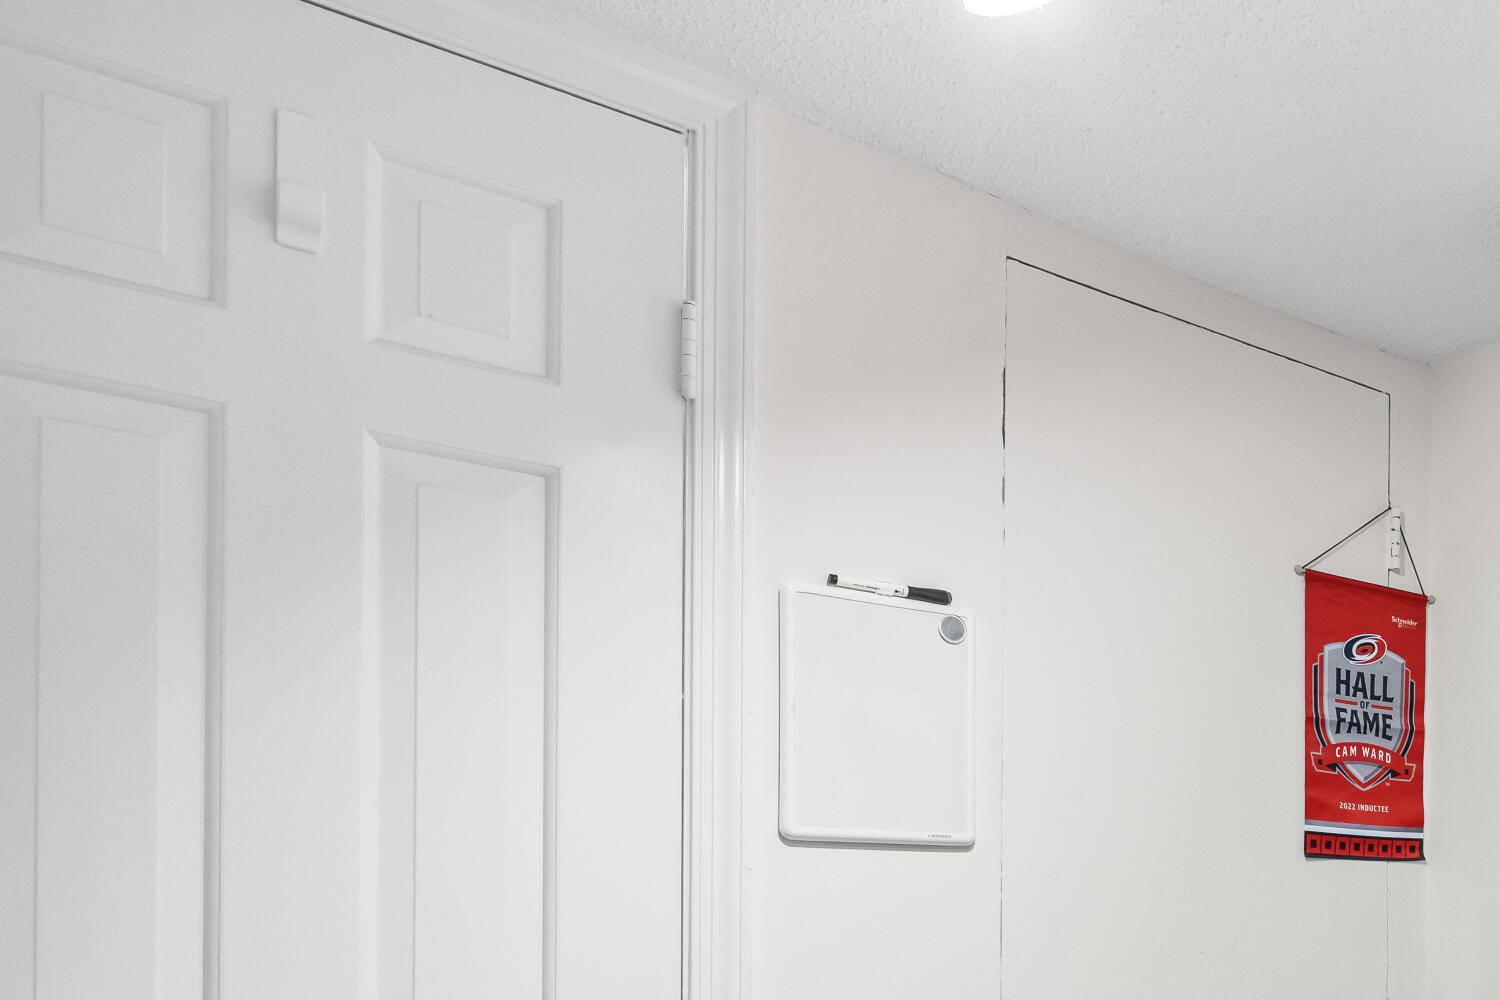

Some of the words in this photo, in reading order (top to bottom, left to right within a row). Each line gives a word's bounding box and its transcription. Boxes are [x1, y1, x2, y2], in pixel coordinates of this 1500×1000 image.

[1391, 616, 1418, 629] Schneider
[1335, 667, 1395, 703] HALL
[1359, 700, 1371, 710] OF
[1335, 709, 1394, 741] FAME
[1335, 746, 1358, 758] CAM
[1362, 746, 1392, 764] WARD
[1339, 801, 1357, 812] 2022
[1357, 803, 1390, 813] INDUCTEE
